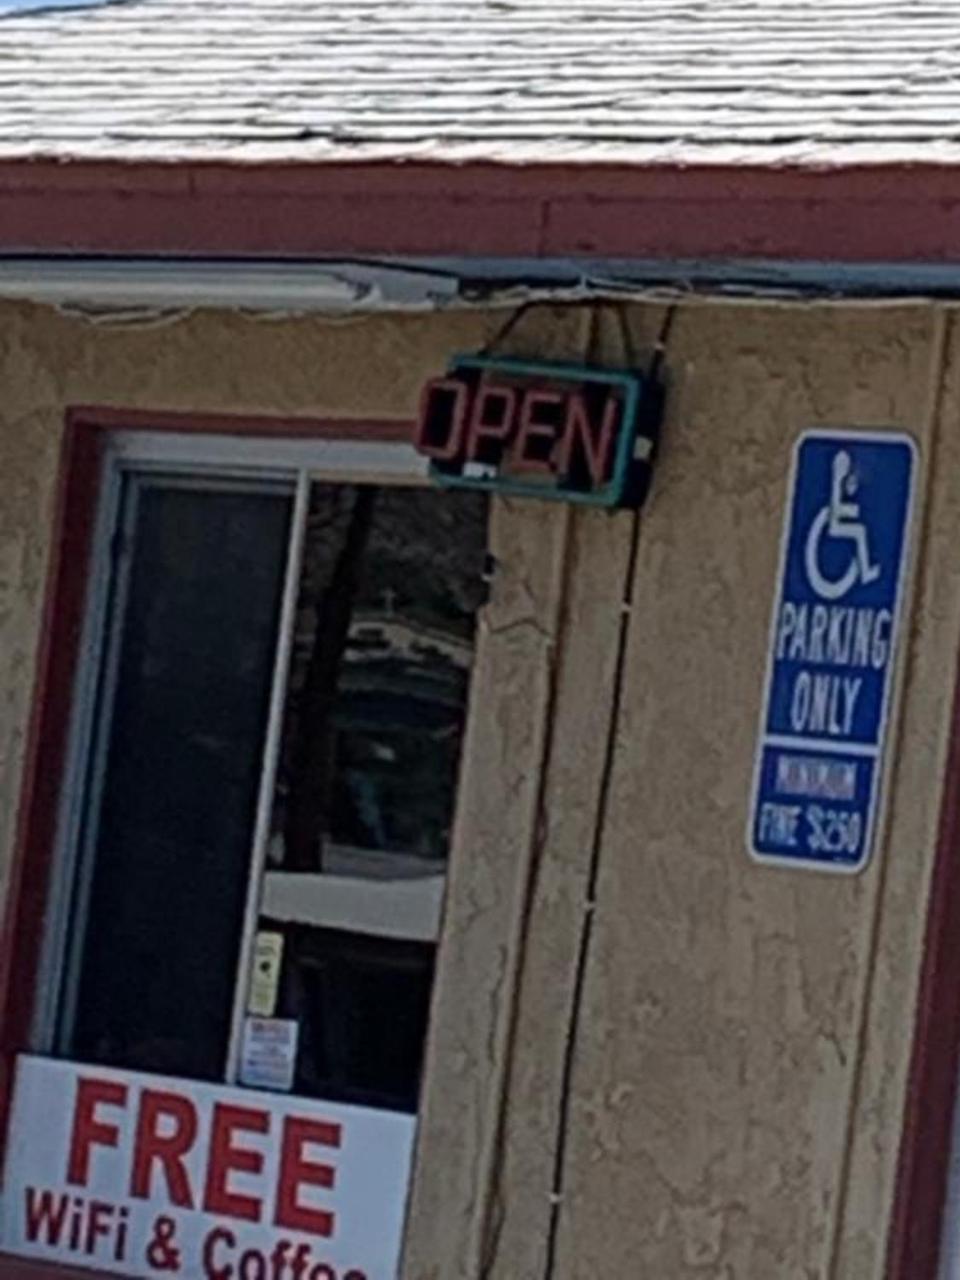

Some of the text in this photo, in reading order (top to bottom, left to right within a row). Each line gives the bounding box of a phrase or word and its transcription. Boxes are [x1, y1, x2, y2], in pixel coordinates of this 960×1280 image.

[416, 377, 619, 488] OPEN
[776, 602, 892, 669] PARKING
[790, 672, 862, 735] ONLY
[66, 1077, 342, 1238] FREE
[25, 1187, 367, 1280] WiFi & Coff
